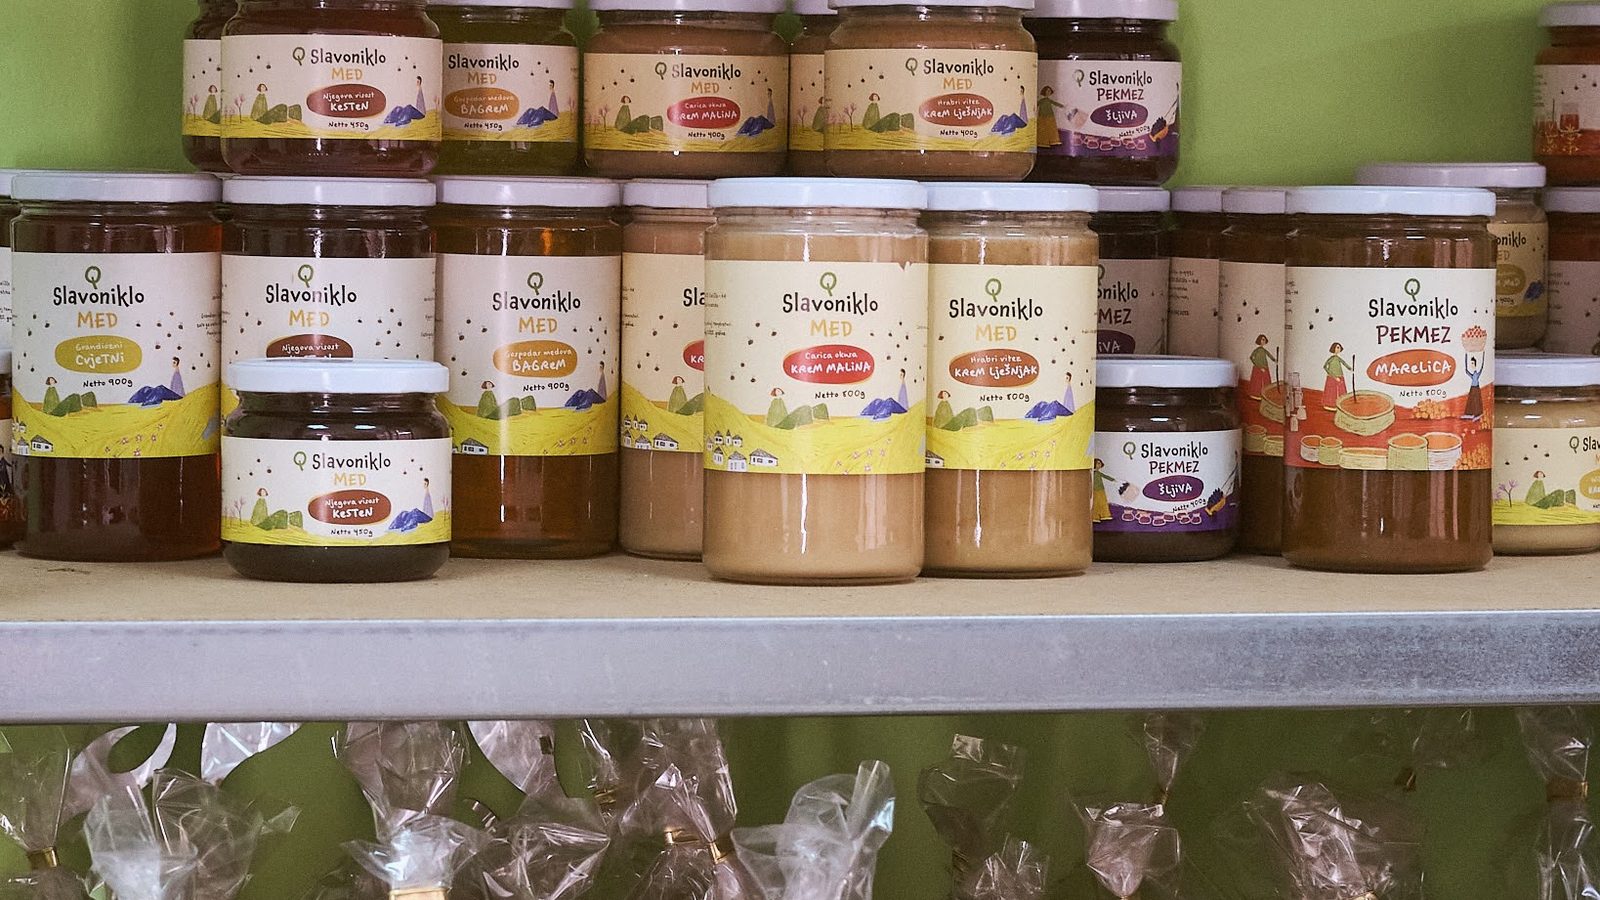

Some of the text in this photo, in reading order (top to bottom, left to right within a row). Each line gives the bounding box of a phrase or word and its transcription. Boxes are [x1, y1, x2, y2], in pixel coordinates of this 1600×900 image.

[310, 46, 387, 66] Slavoniklo
[448, 53, 520, 71] Slavoniklo
[331, 67, 364, 81] MED
[672, 62, 742, 81] Slavoniklo
[923, 58, 995, 77] Slavoniklo
[467, 71, 498, 86] MED
[943, 78, 973, 91] MED
[1089, 69, 1153, 89] Slavoniklo
[690, 82, 720, 95] MED
[1097, 88, 1145, 101] PEKMEZ
[328, 121, 370, 131] Netto 450g
[484, 122, 503, 132] 450g
[939, 129, 978, 139] Netto 400g
[707, 131, 726, 140] 400g
[53, 284, 145, 308] Slavoniklo
[265, 283, 357, 307] Slavoniklo
[492, 290, 581, 313] Slavoniklo
[782, 291, 879, 316] Slavoniklo
[949, 297, 1044, 321] Slavoniklo
[1368, 297, 1459, 319] Slavoniklo
[77, 311, 118, 329] MED
[289, 309, 330, 328] MED
[518, 316, 558, 334] MED
[810, 319, 853, 337] MED
[975, 324, 1017, 342] MED
[1376, 325, 1451, 345] PEKMEZ
[804, 352, 832, 360] Carica
[970, 354, 997, 363] Hrabri
[83, 378, 133, 388] Netto 900g
[523, 381, 570, 392] Netto 900g
[814, 391, 839, 399] Netto
[979, 393, 1003, 402] Netto
[1400, 390, 1423, 398] Netto
[1141, 441, 1208, 459] Slavoniklo
[312, 451, 391, 471] Slavoniklo
[1149, 461, 1200, 475] PEKMEZ
[334, 472, 367, 486] MED
[353, 528, 373, 537] 450g
